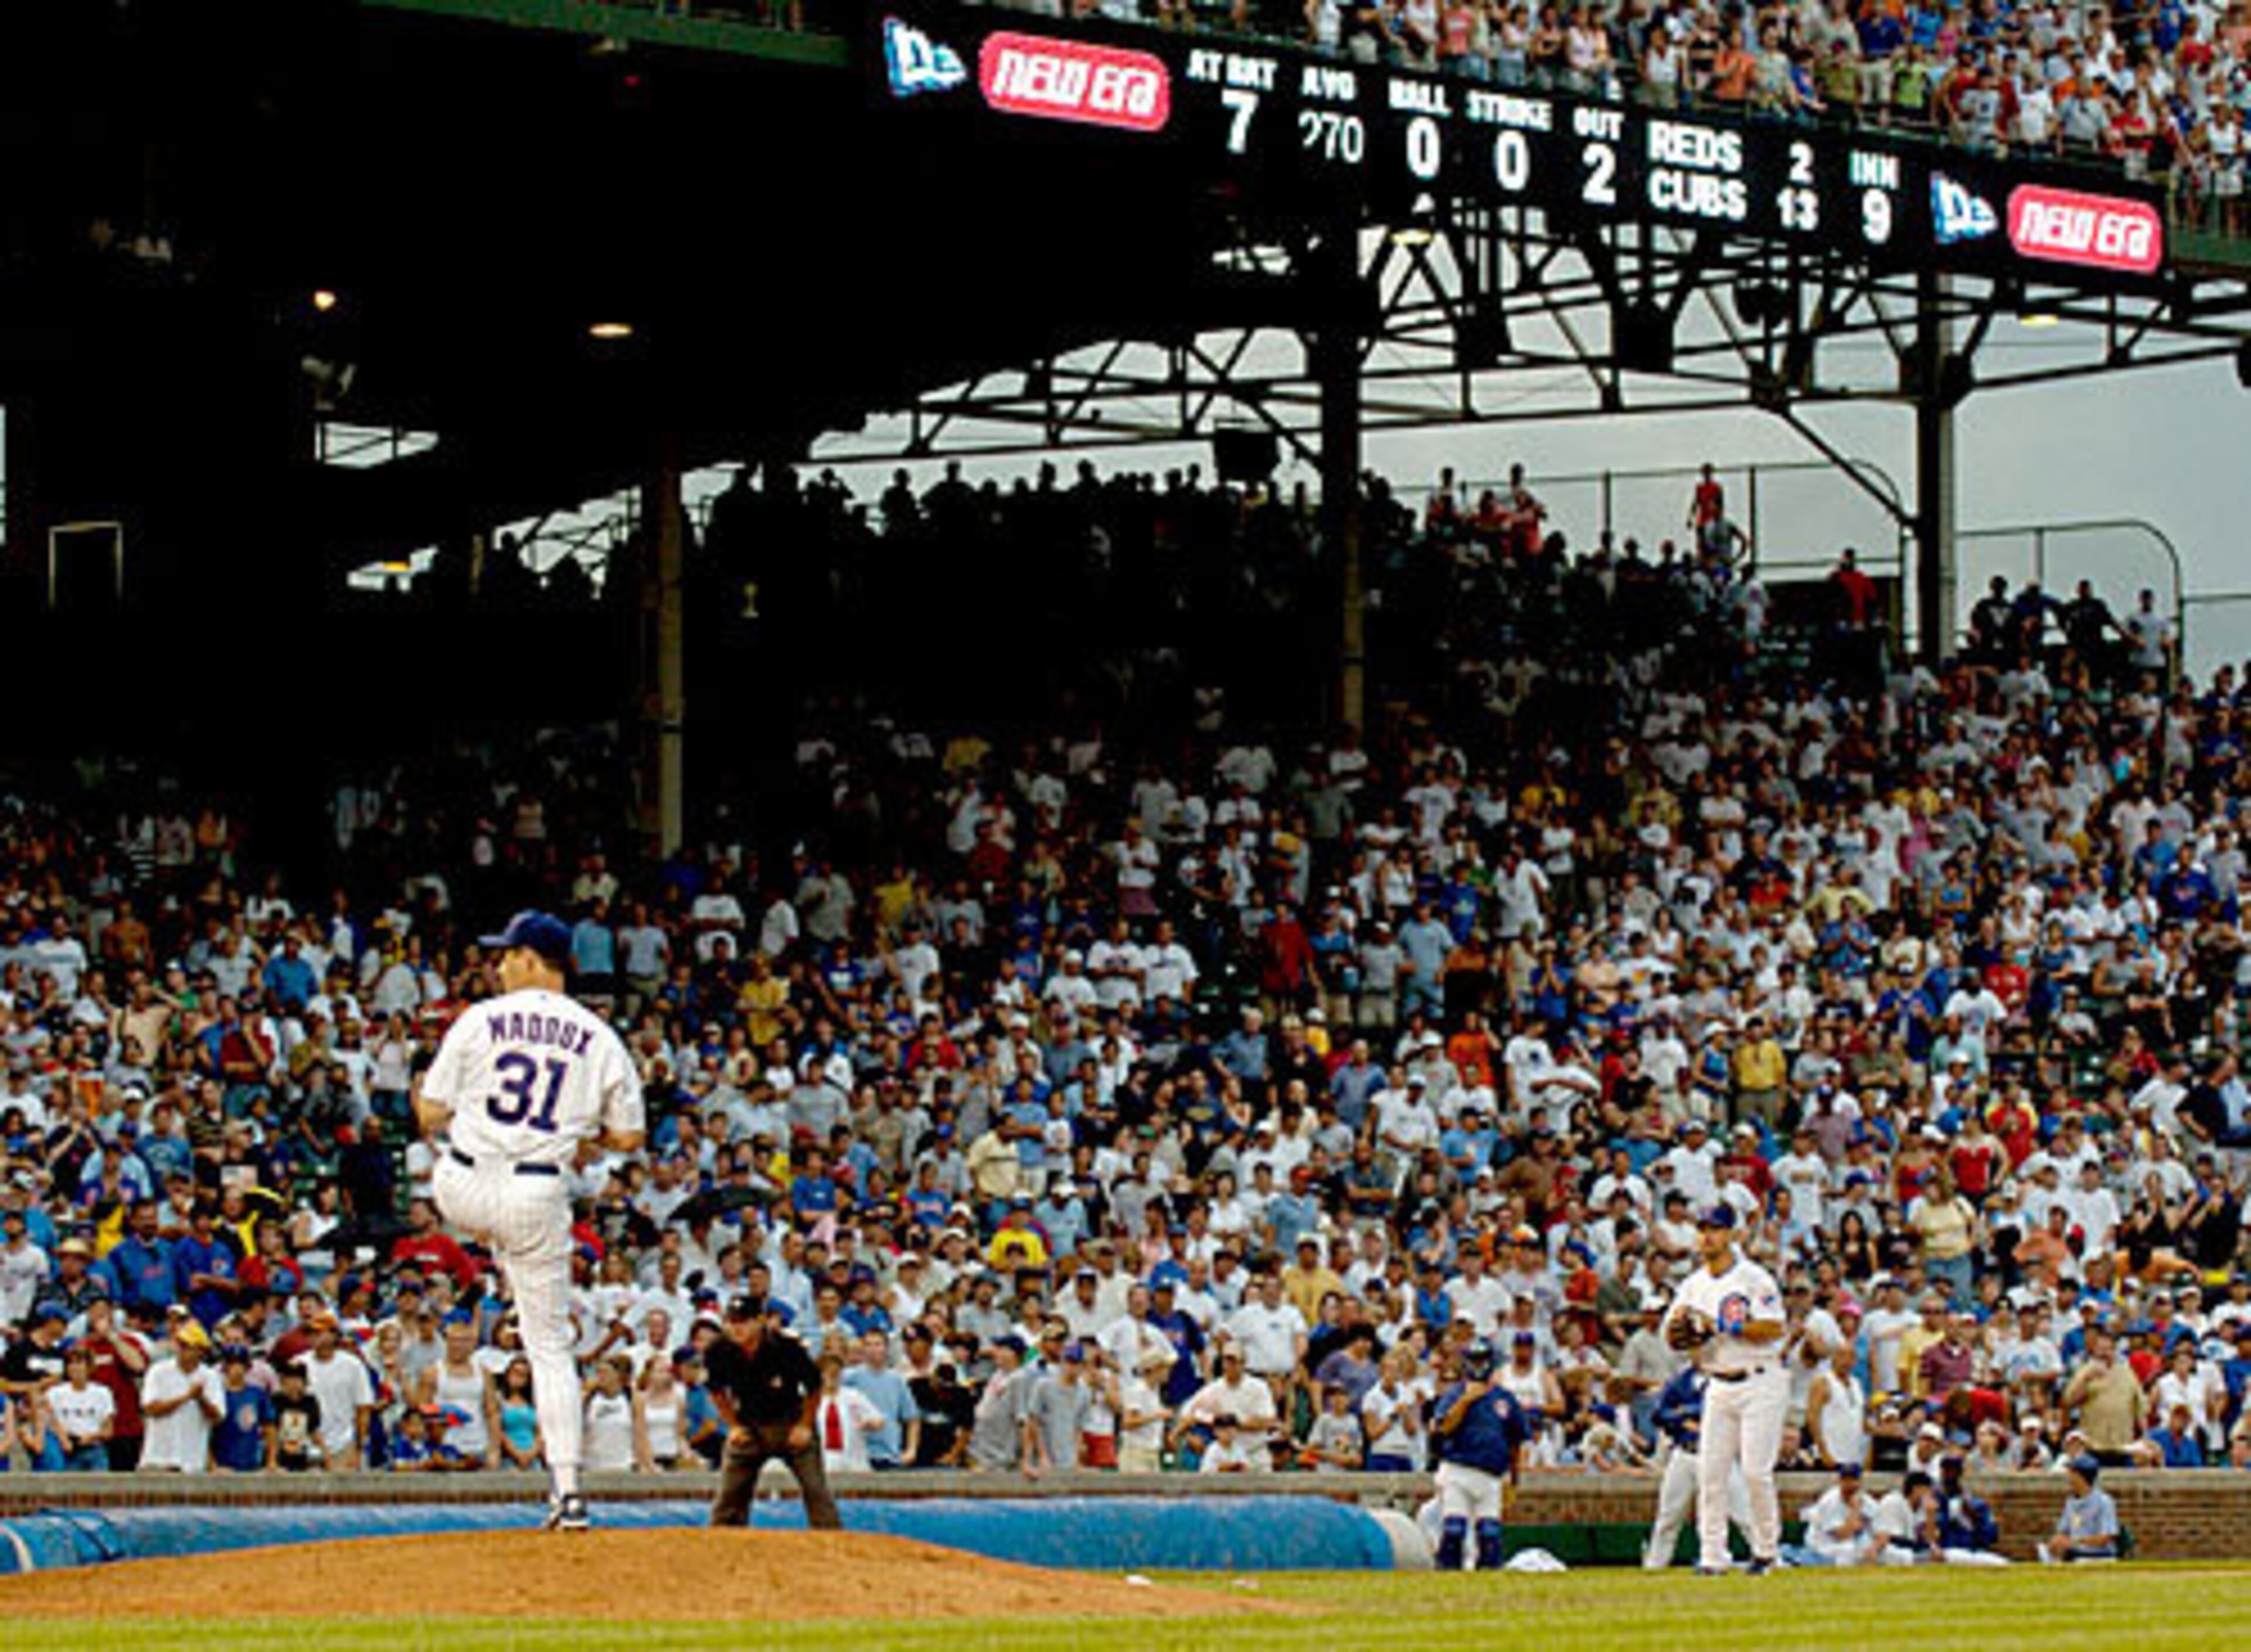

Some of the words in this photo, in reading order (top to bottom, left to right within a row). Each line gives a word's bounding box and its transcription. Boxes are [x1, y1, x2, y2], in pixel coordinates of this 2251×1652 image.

[1222, 91, 1257, 152] 7
[1389, 80, 1450, 115] BALL
[1467, 92, 1551, 130] STRIKE
[1575, 110, 1623, 139] OUT
[1408, 119, 1439, 177] 0
[1495, 131, 1528, 189] 0
[1583, 145, 1615, 203] 2
[1648, 122, 1741, 171] REDS
[1790, 144, 1812, 182] 2
[1850, 152, 1898, 188] INN
[1650, 170, 1745, 220] CUBS
[1777, 190, 1816, 229] 13
[1863, 190, 1890, 242] 9
[486, 1051, 568, 1132] 31
